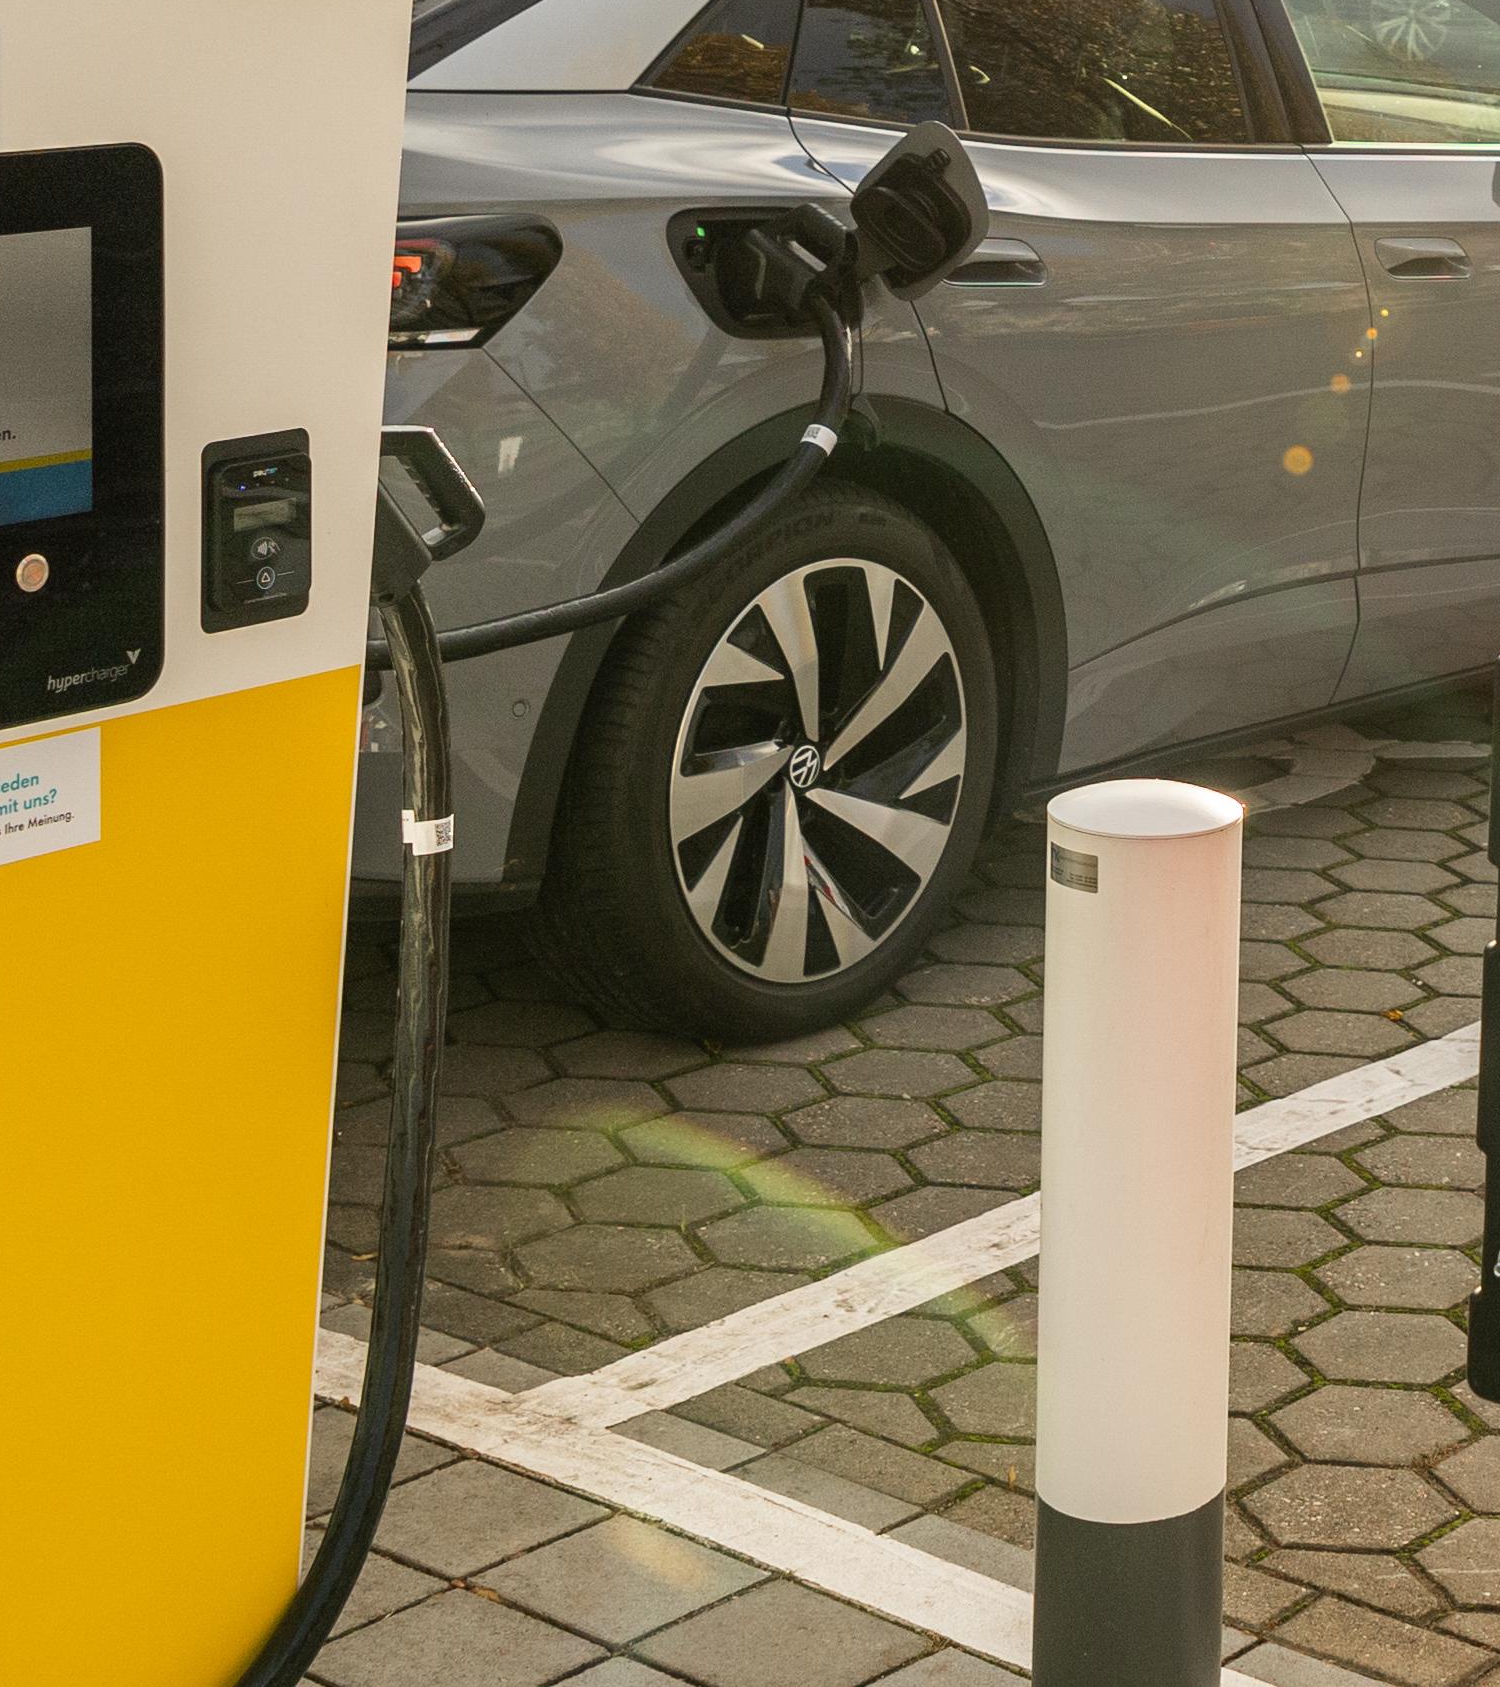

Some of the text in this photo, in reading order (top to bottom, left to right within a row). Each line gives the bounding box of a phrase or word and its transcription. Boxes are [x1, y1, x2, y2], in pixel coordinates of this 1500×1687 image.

[47, 664, 131, 694] hypercharger
[24, 788, 58, 811] uns?
[5, 822, 25, 835] Ihre
[28, 810, 75, 830] Meinung.
